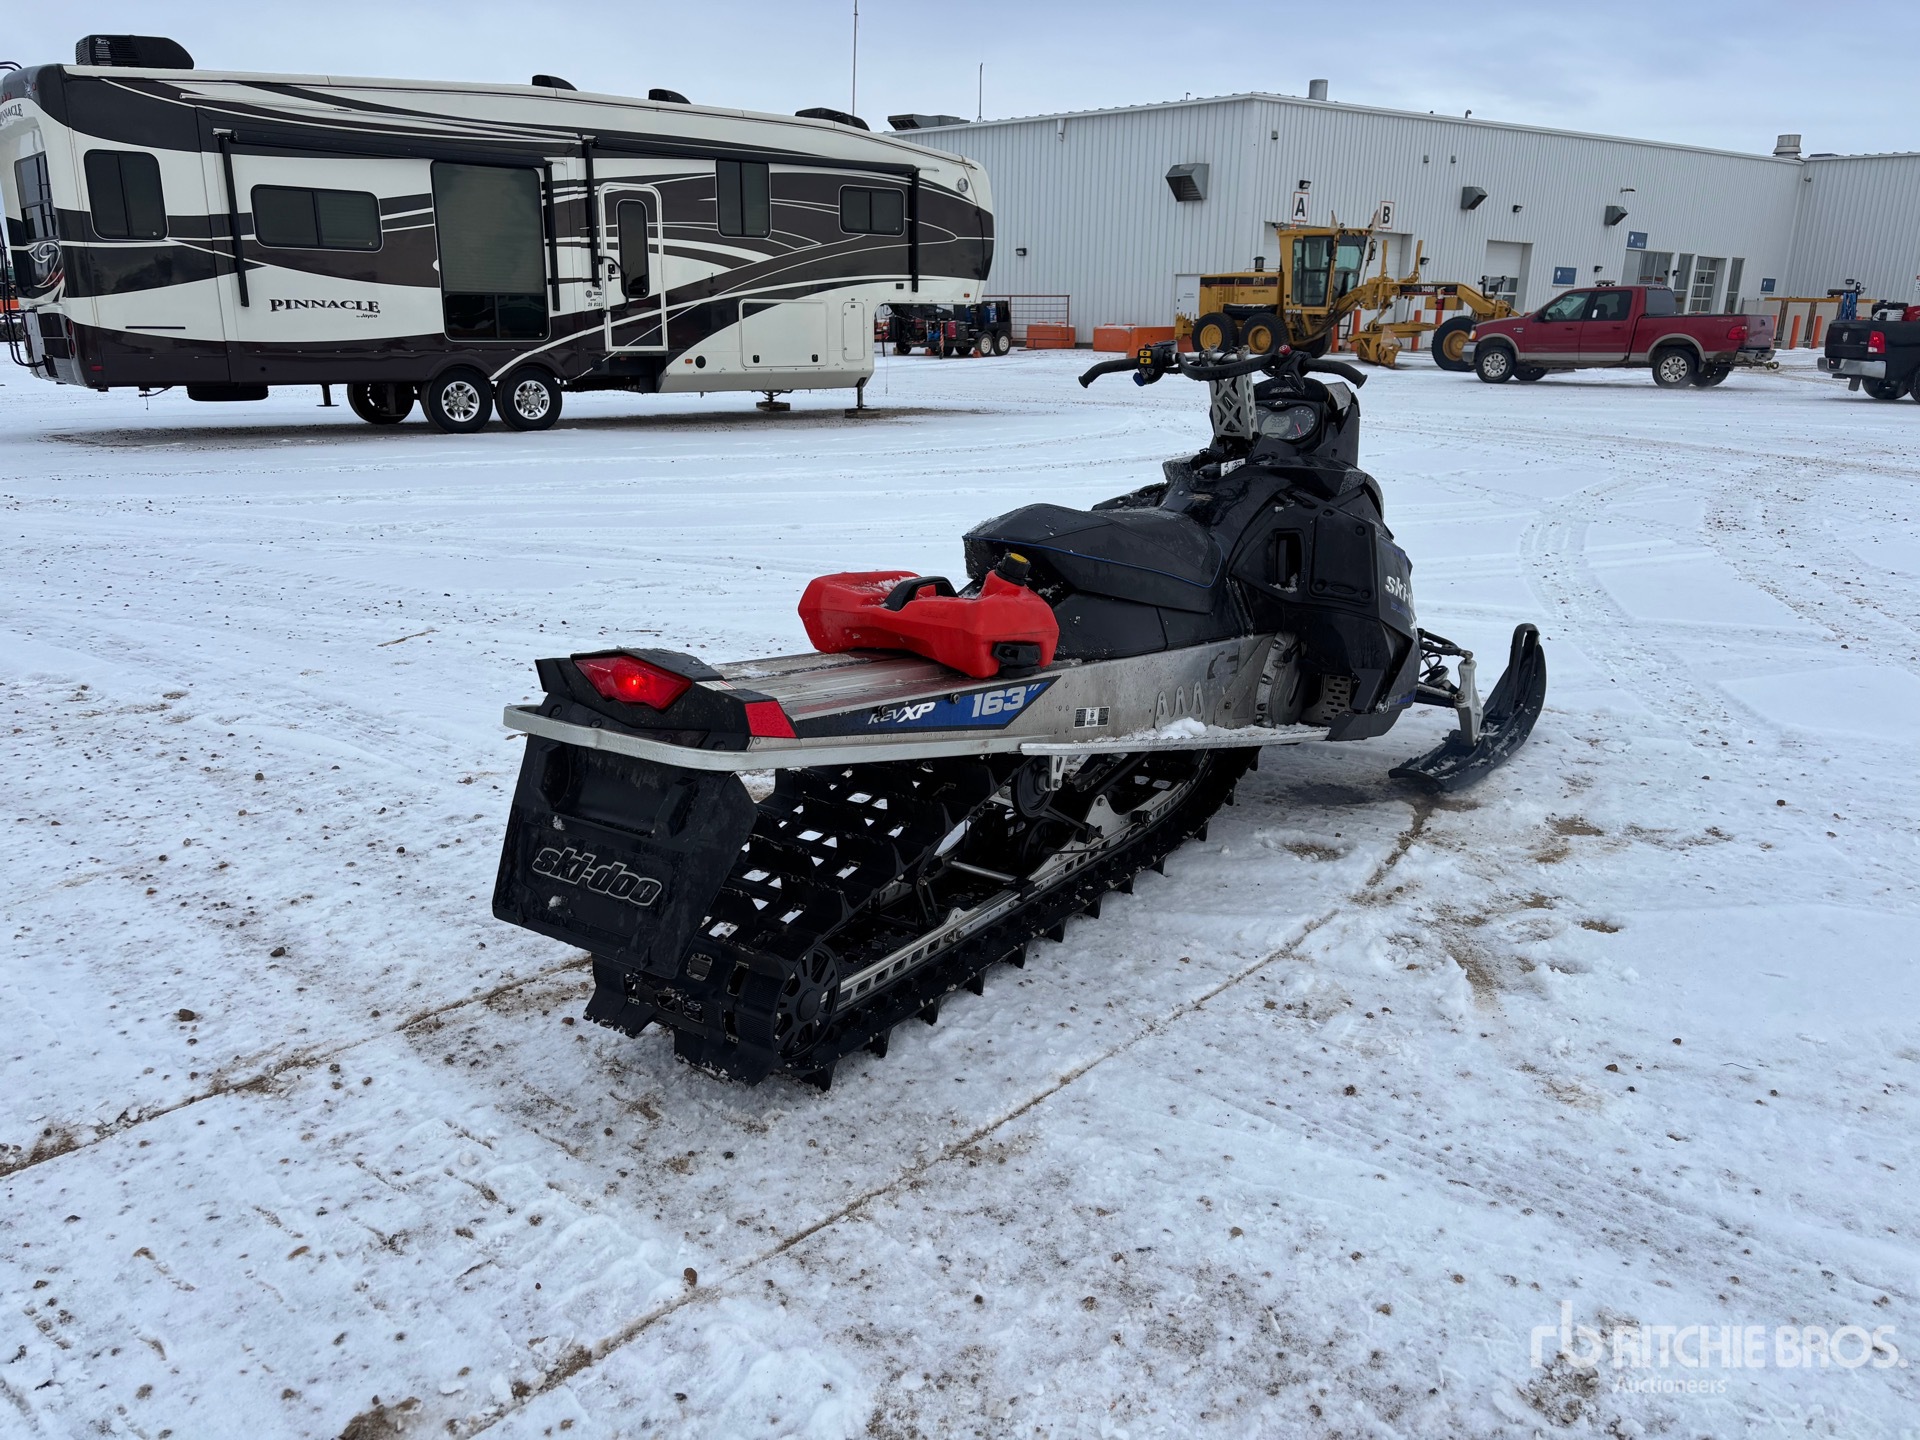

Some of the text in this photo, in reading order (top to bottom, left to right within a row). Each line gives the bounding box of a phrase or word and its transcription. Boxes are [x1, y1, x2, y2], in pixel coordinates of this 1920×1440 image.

[1295, 197, 1306, 217] A
[1382, 206, 1391, 224] B
[269, 299, 381, 314] PINNACLE
[531, 846, 662, 906] ski-doo
